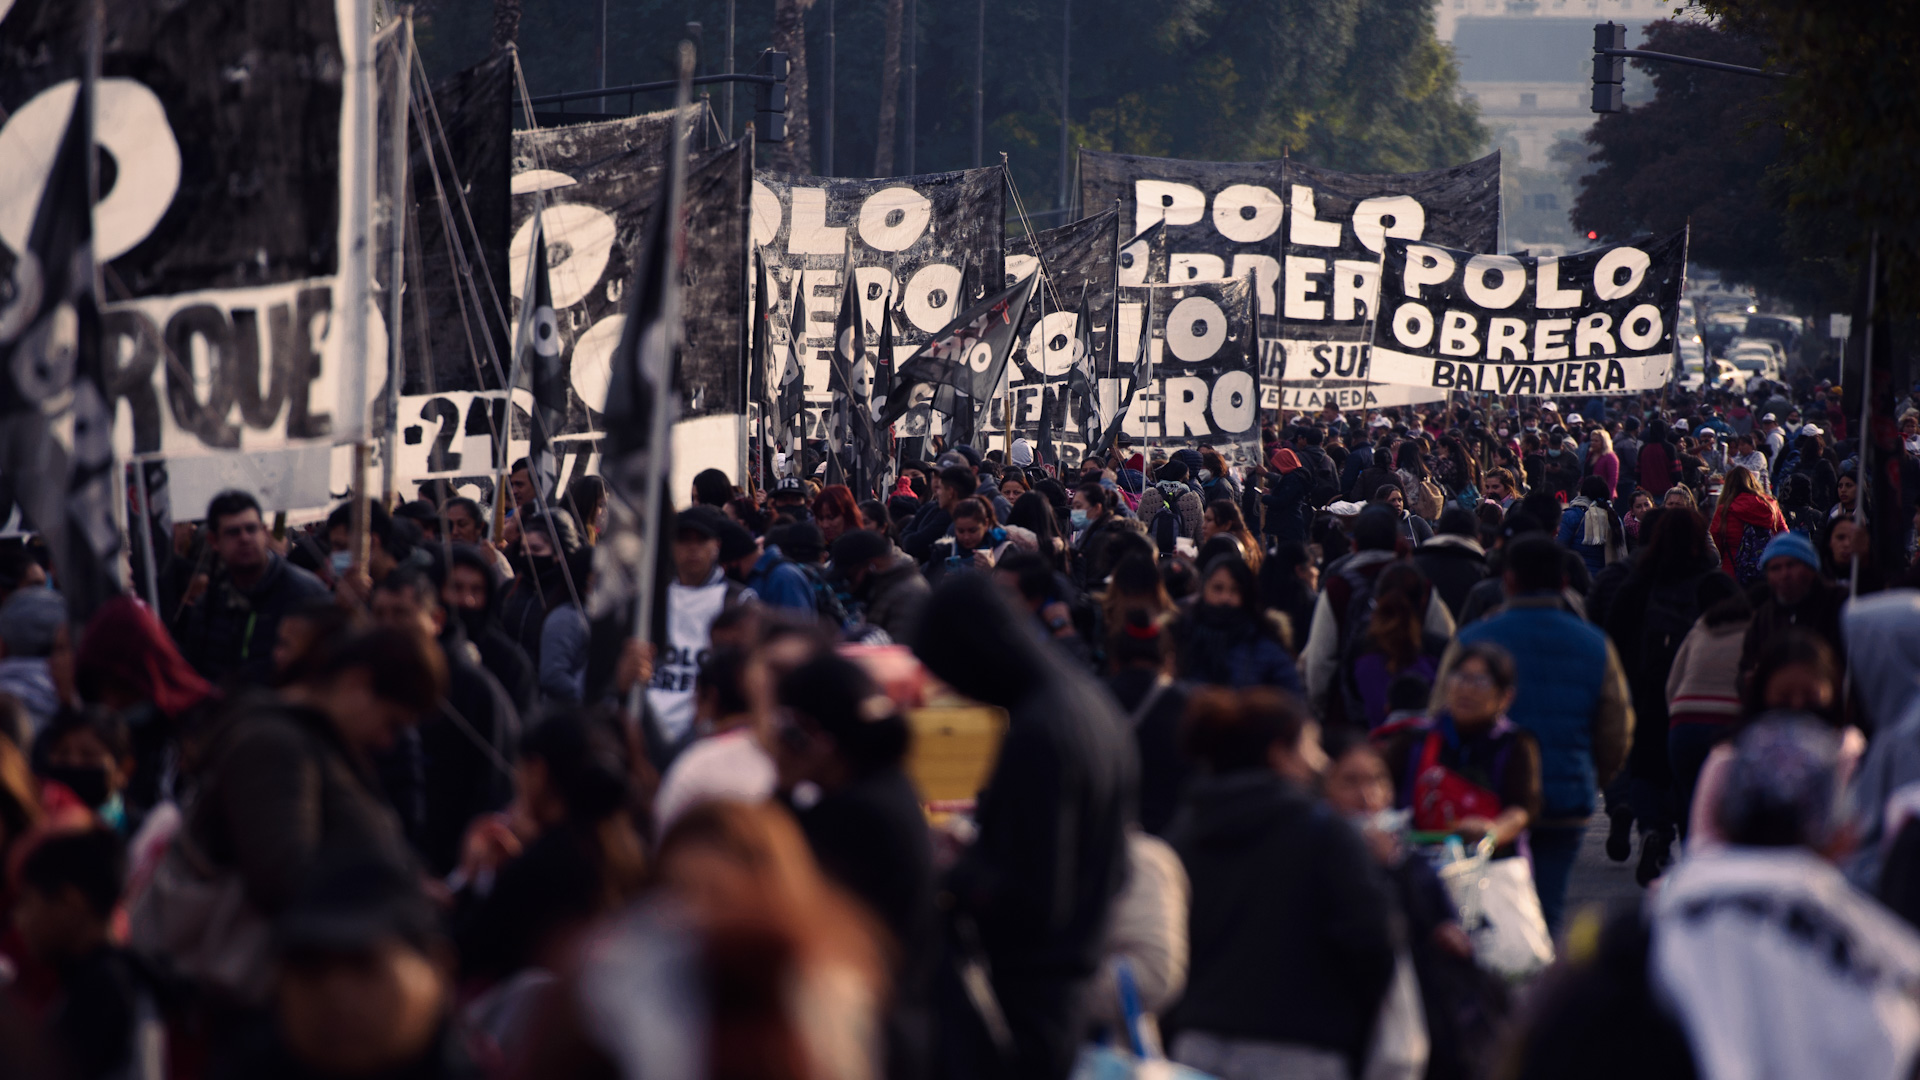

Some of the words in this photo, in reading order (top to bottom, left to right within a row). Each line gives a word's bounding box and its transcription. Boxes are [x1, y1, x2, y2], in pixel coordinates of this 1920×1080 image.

[1135, 180, 1425, 254] POLO
[1403, 245, 1651, 309] POLO
[1392, 301, 1663, 361] OBRERO
[1432, 359, 1626, 395] BALVANERA
